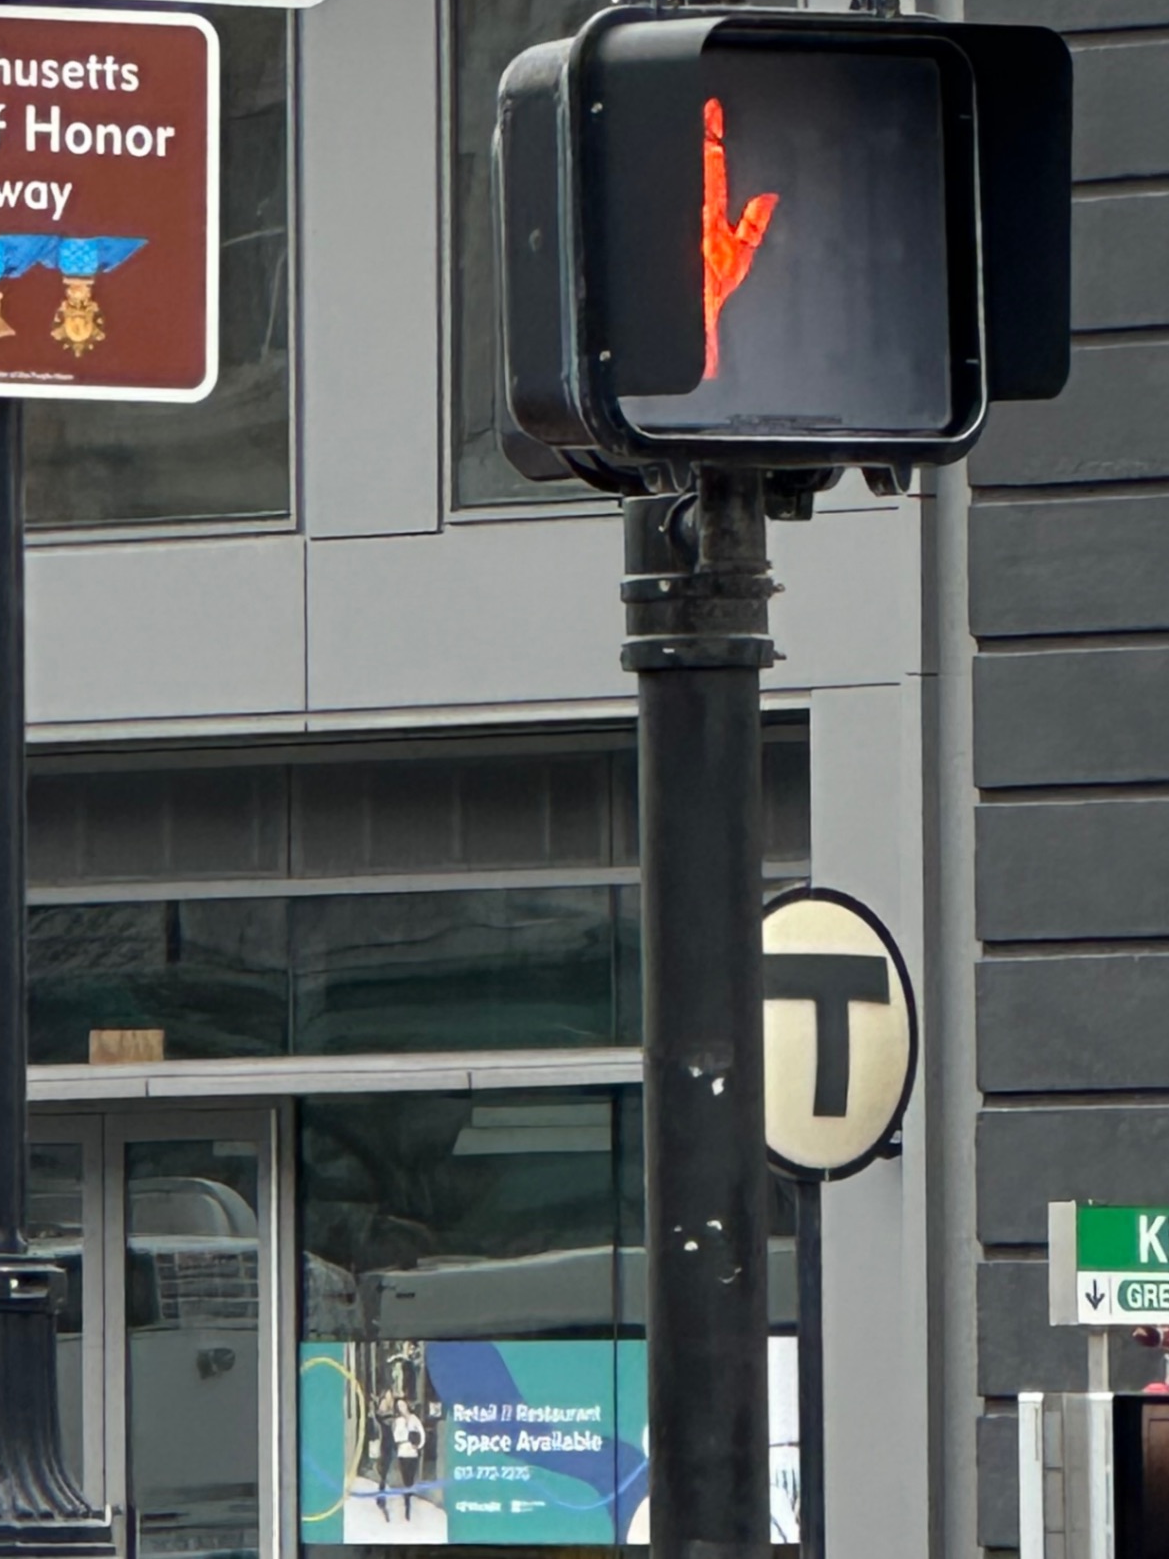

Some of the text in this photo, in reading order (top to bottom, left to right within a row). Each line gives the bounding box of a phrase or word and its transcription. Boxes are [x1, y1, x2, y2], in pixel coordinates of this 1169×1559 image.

[25, 105, 175, 157] Honor
[762, 953, 891, 1118] T
[453, 1404, 497, 1422] Retail
[516, 1404, 601, 1422] Restaurant
[454, 1430, 603, 1456] Space Available
